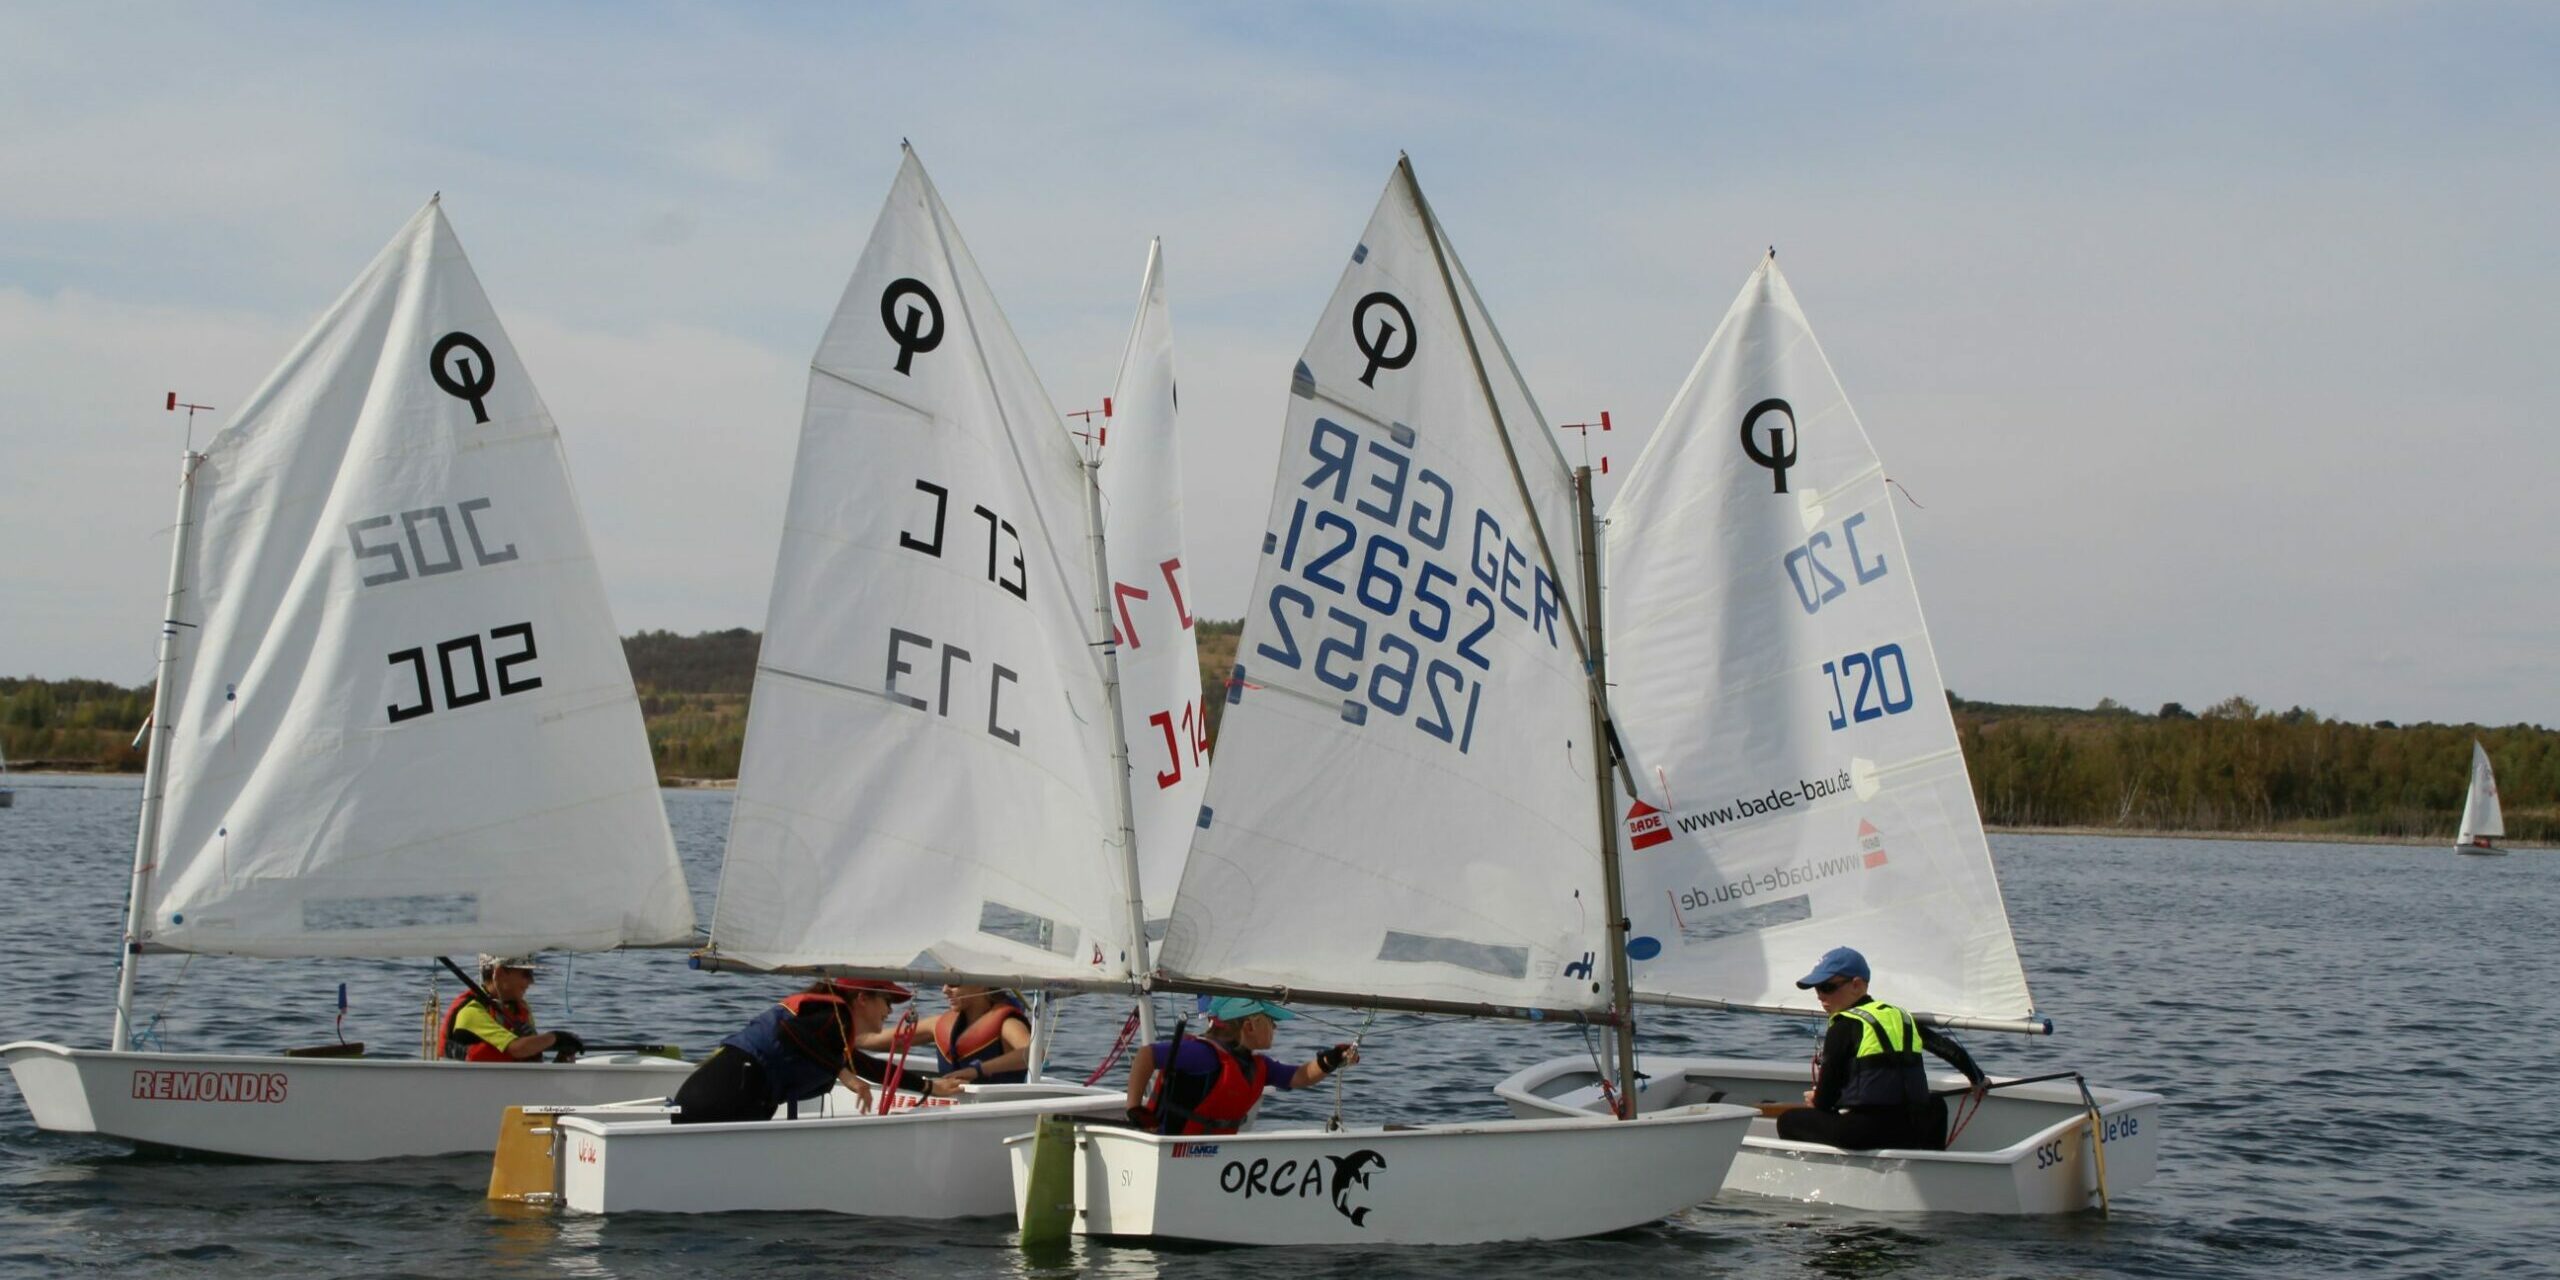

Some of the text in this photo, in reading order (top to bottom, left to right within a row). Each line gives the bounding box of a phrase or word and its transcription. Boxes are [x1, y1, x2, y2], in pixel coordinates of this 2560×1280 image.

[1280, 498, 1495, 671] 12652
[1470, 508, 1560, 649] GER
[1677, 769, 1852, 834] www.bade-bau.de
[1629, 816, 1662, 834] BADE
[132, 1070, 288, 1103] REMONDIS
[2037, 1140, 2063, 1170] SSC
[1121, 1169, 1134, 1187] SV
[1220, 1157, 1322, 1199] ORCA
